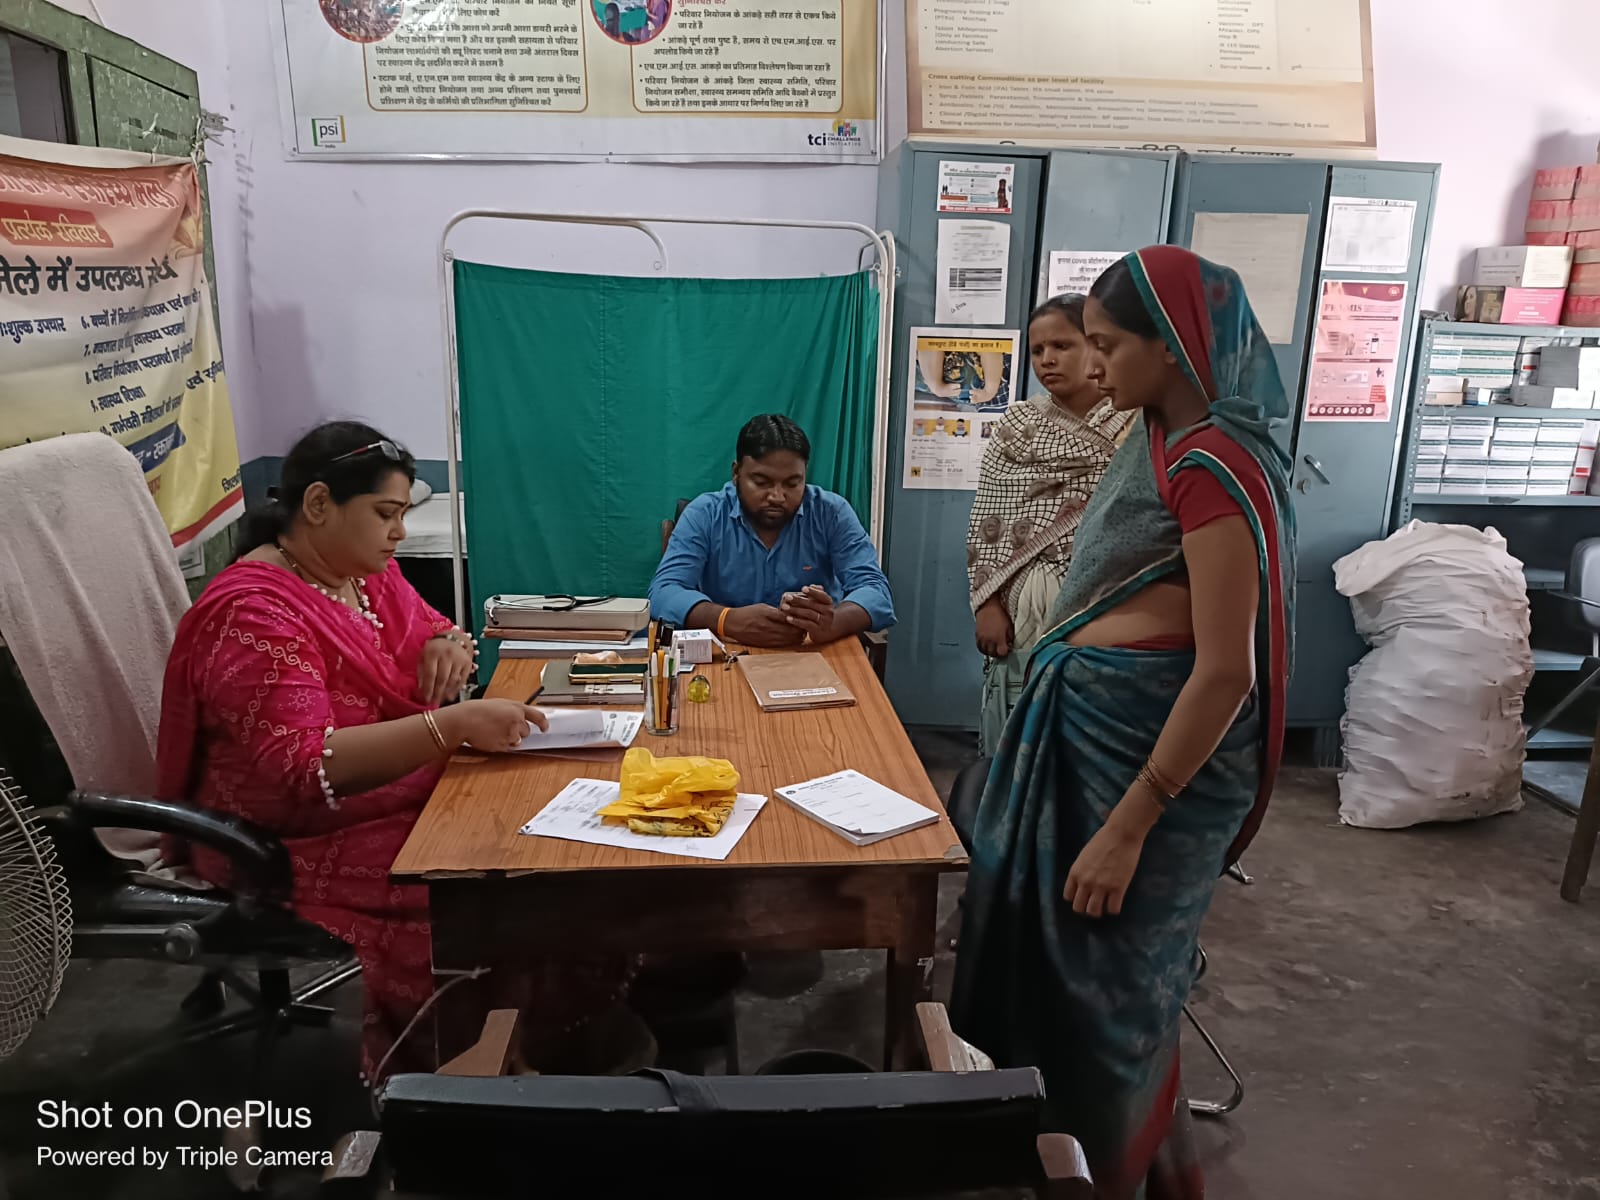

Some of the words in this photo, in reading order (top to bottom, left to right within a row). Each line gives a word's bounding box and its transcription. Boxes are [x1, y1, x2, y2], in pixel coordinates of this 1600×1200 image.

[950, 74, 975, 82] cutting
[320, 122, 338, 139] psi
[808, 133, 826, 145] tci
[3, 210, 53, 244] प्रत्येक
[52, 214, 106, 246] रविवार
[46, 256, 72, 293] में
[75, 266, 144, 294] उपलब्ध
[34, 317, 66, 334] उपचार
[110, 410, 141, 434] गर्भवती
